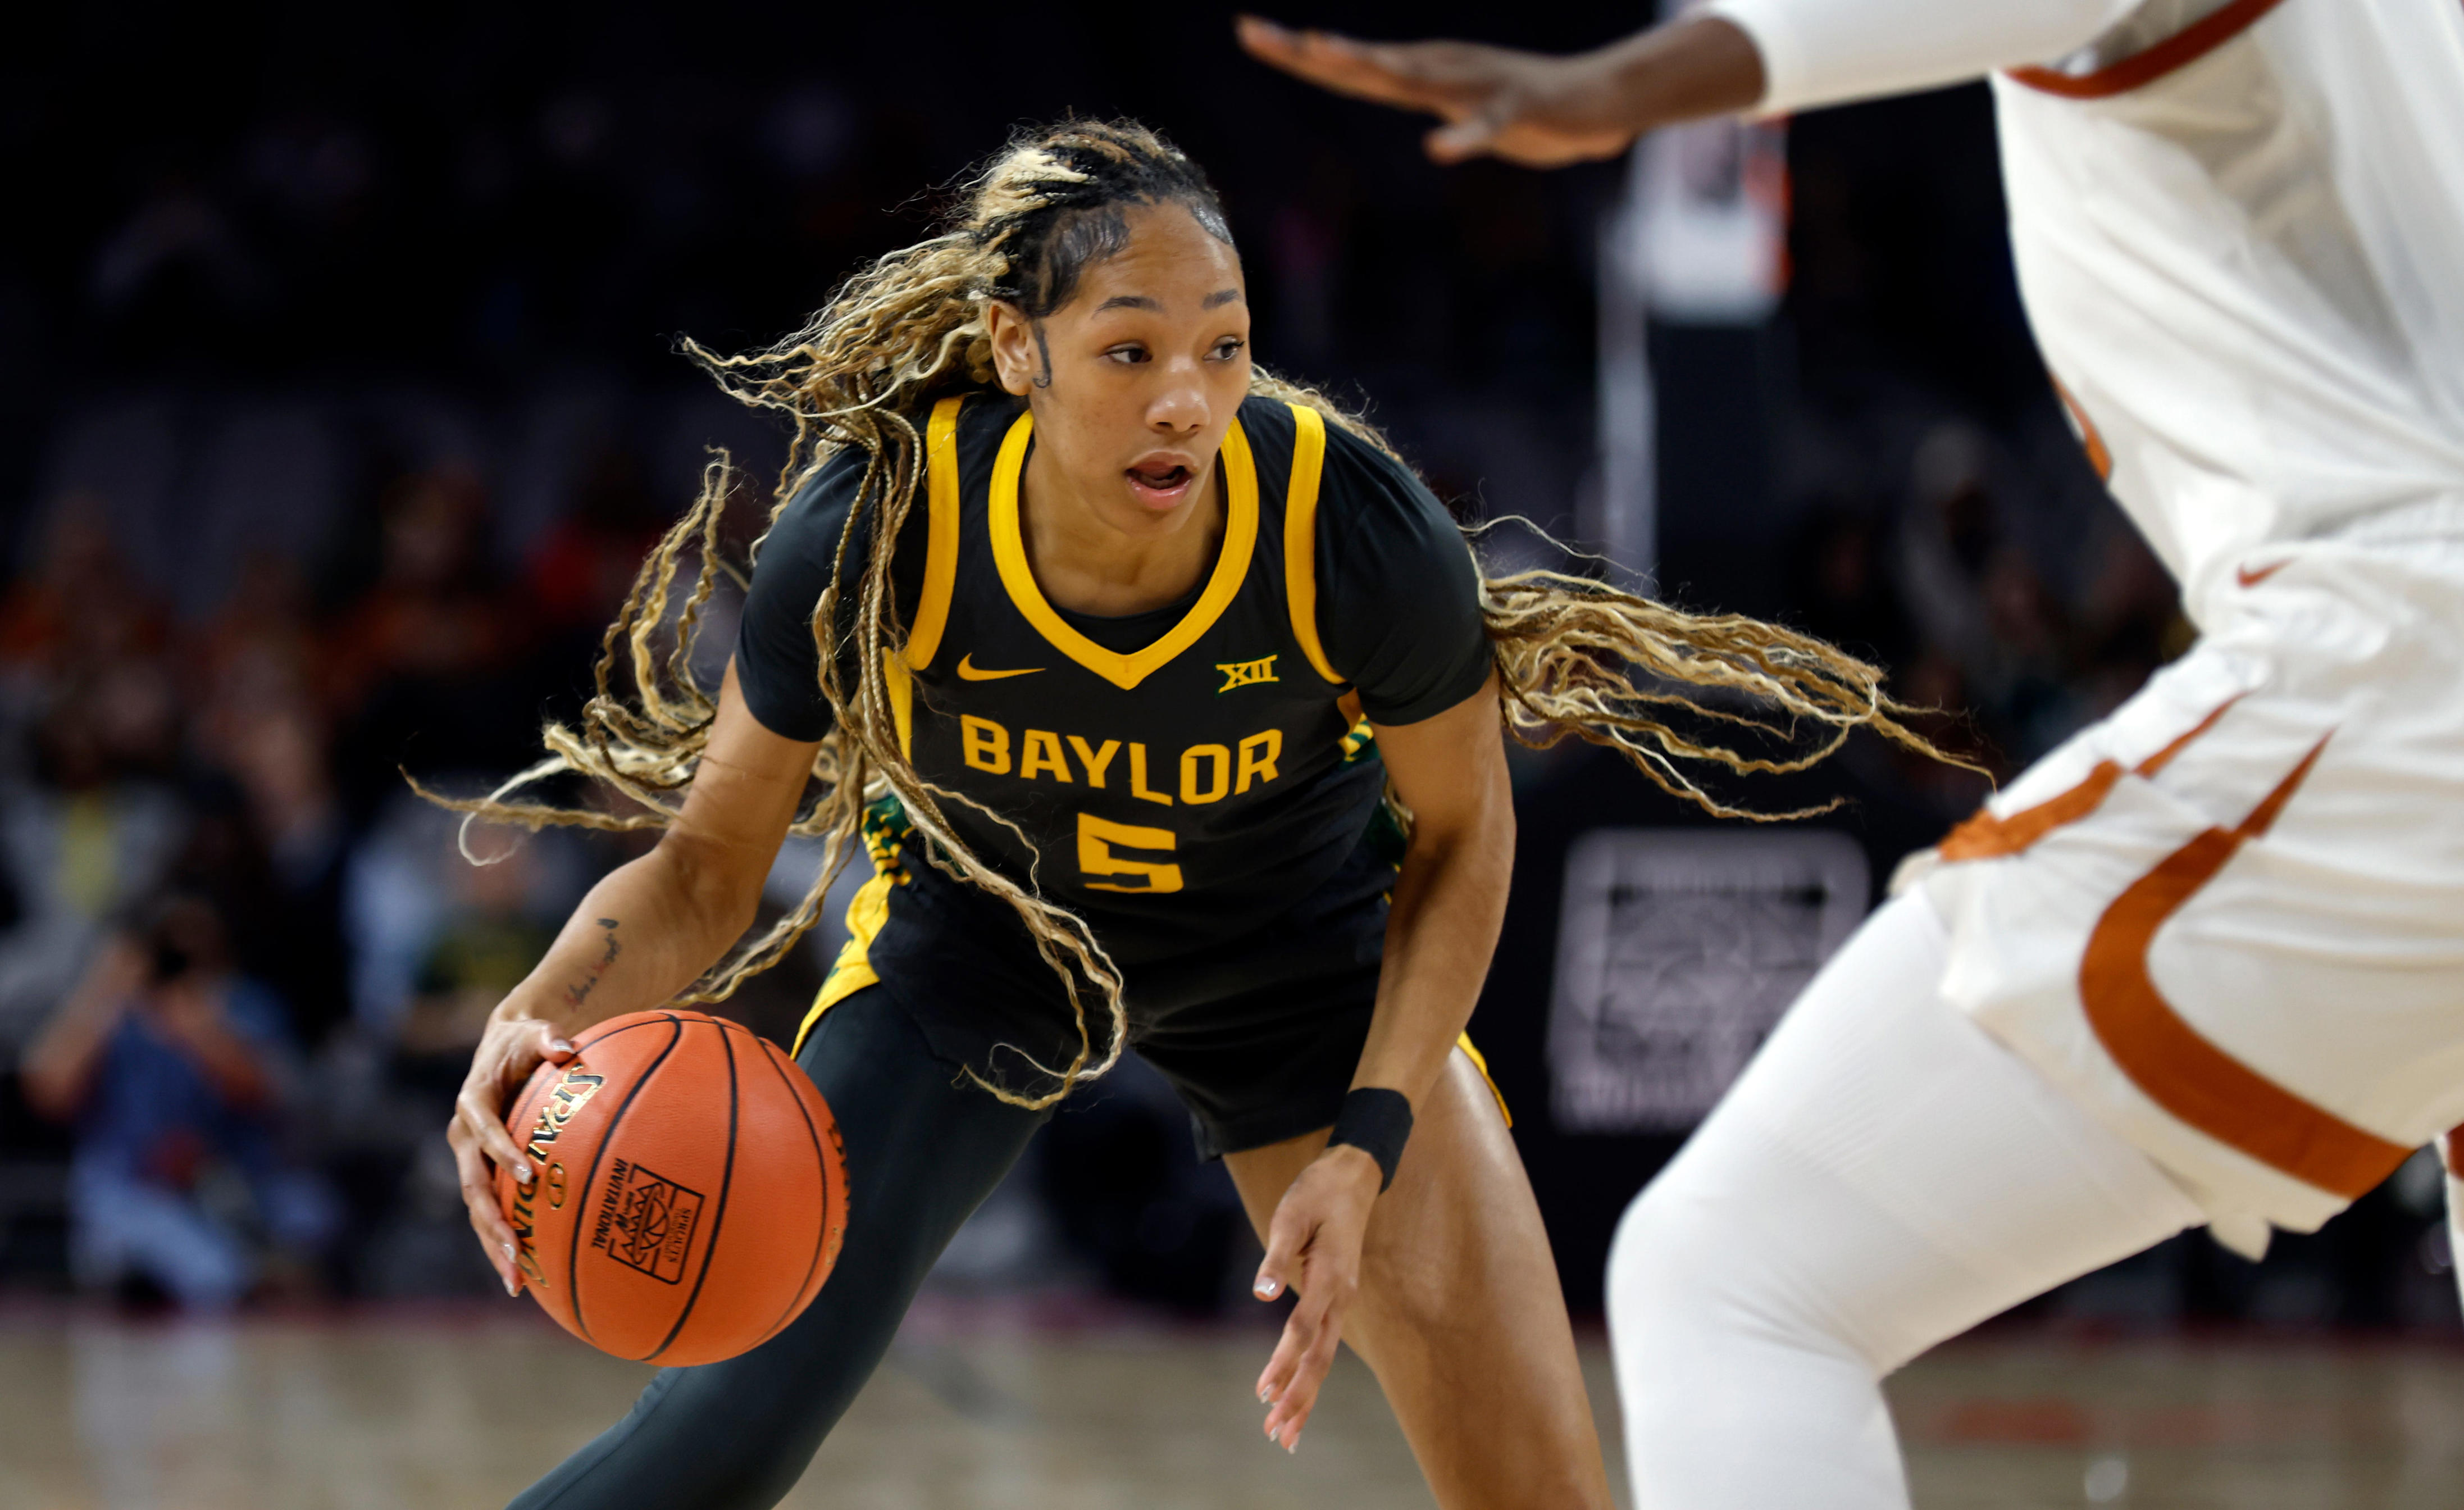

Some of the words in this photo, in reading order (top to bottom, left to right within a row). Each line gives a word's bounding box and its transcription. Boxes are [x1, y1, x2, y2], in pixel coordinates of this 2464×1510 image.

[1215, 654, 1279, 693] XII
[960, 713, 1282, 807] BAYLOR
[1077, 812, 1183, 893] 5
[591, 1157, 628, 1250] INVITATIONAL
